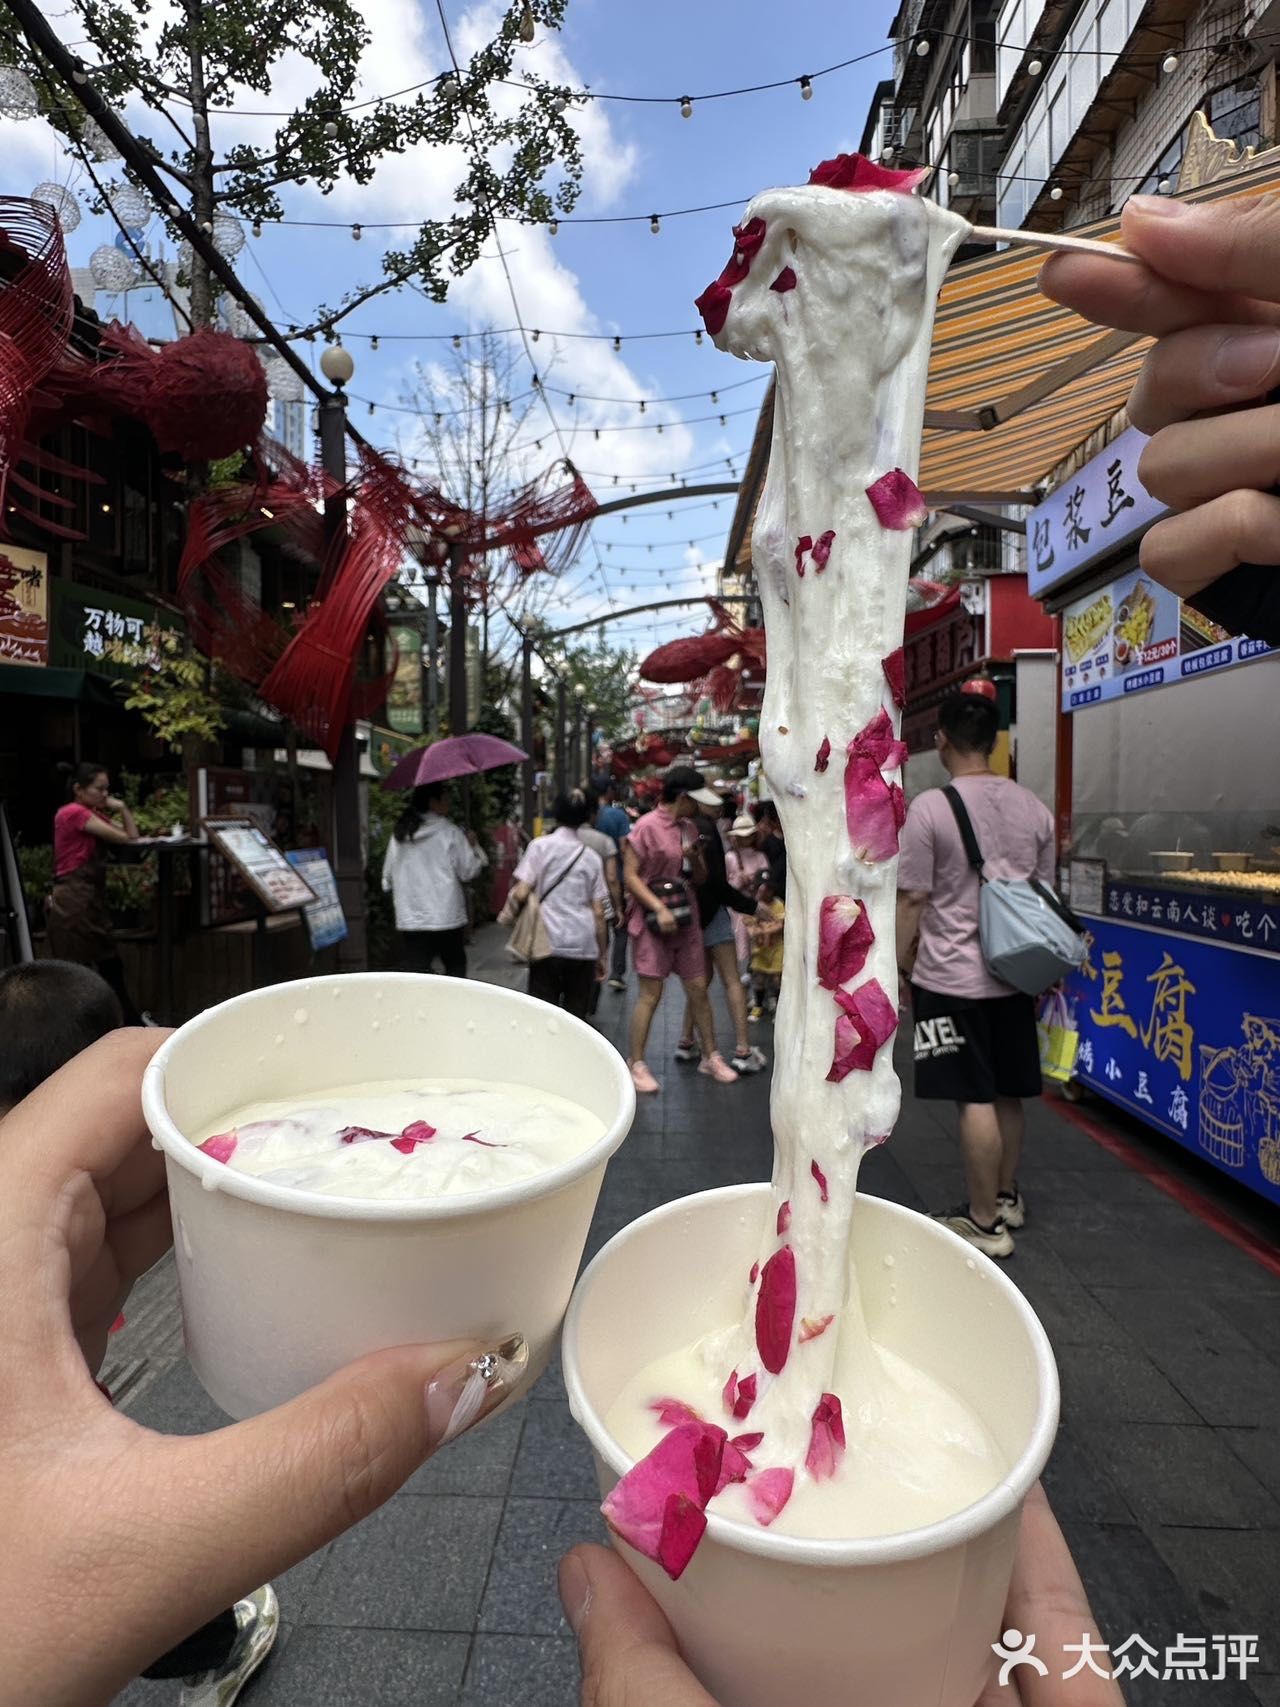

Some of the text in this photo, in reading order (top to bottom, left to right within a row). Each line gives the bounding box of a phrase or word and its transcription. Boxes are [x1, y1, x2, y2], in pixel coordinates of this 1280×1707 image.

[1109, 890, 1277, 942] 恋爱和云南人谈 吃个
[1078, 1038, 1188, 1130] 烤小豆腐
